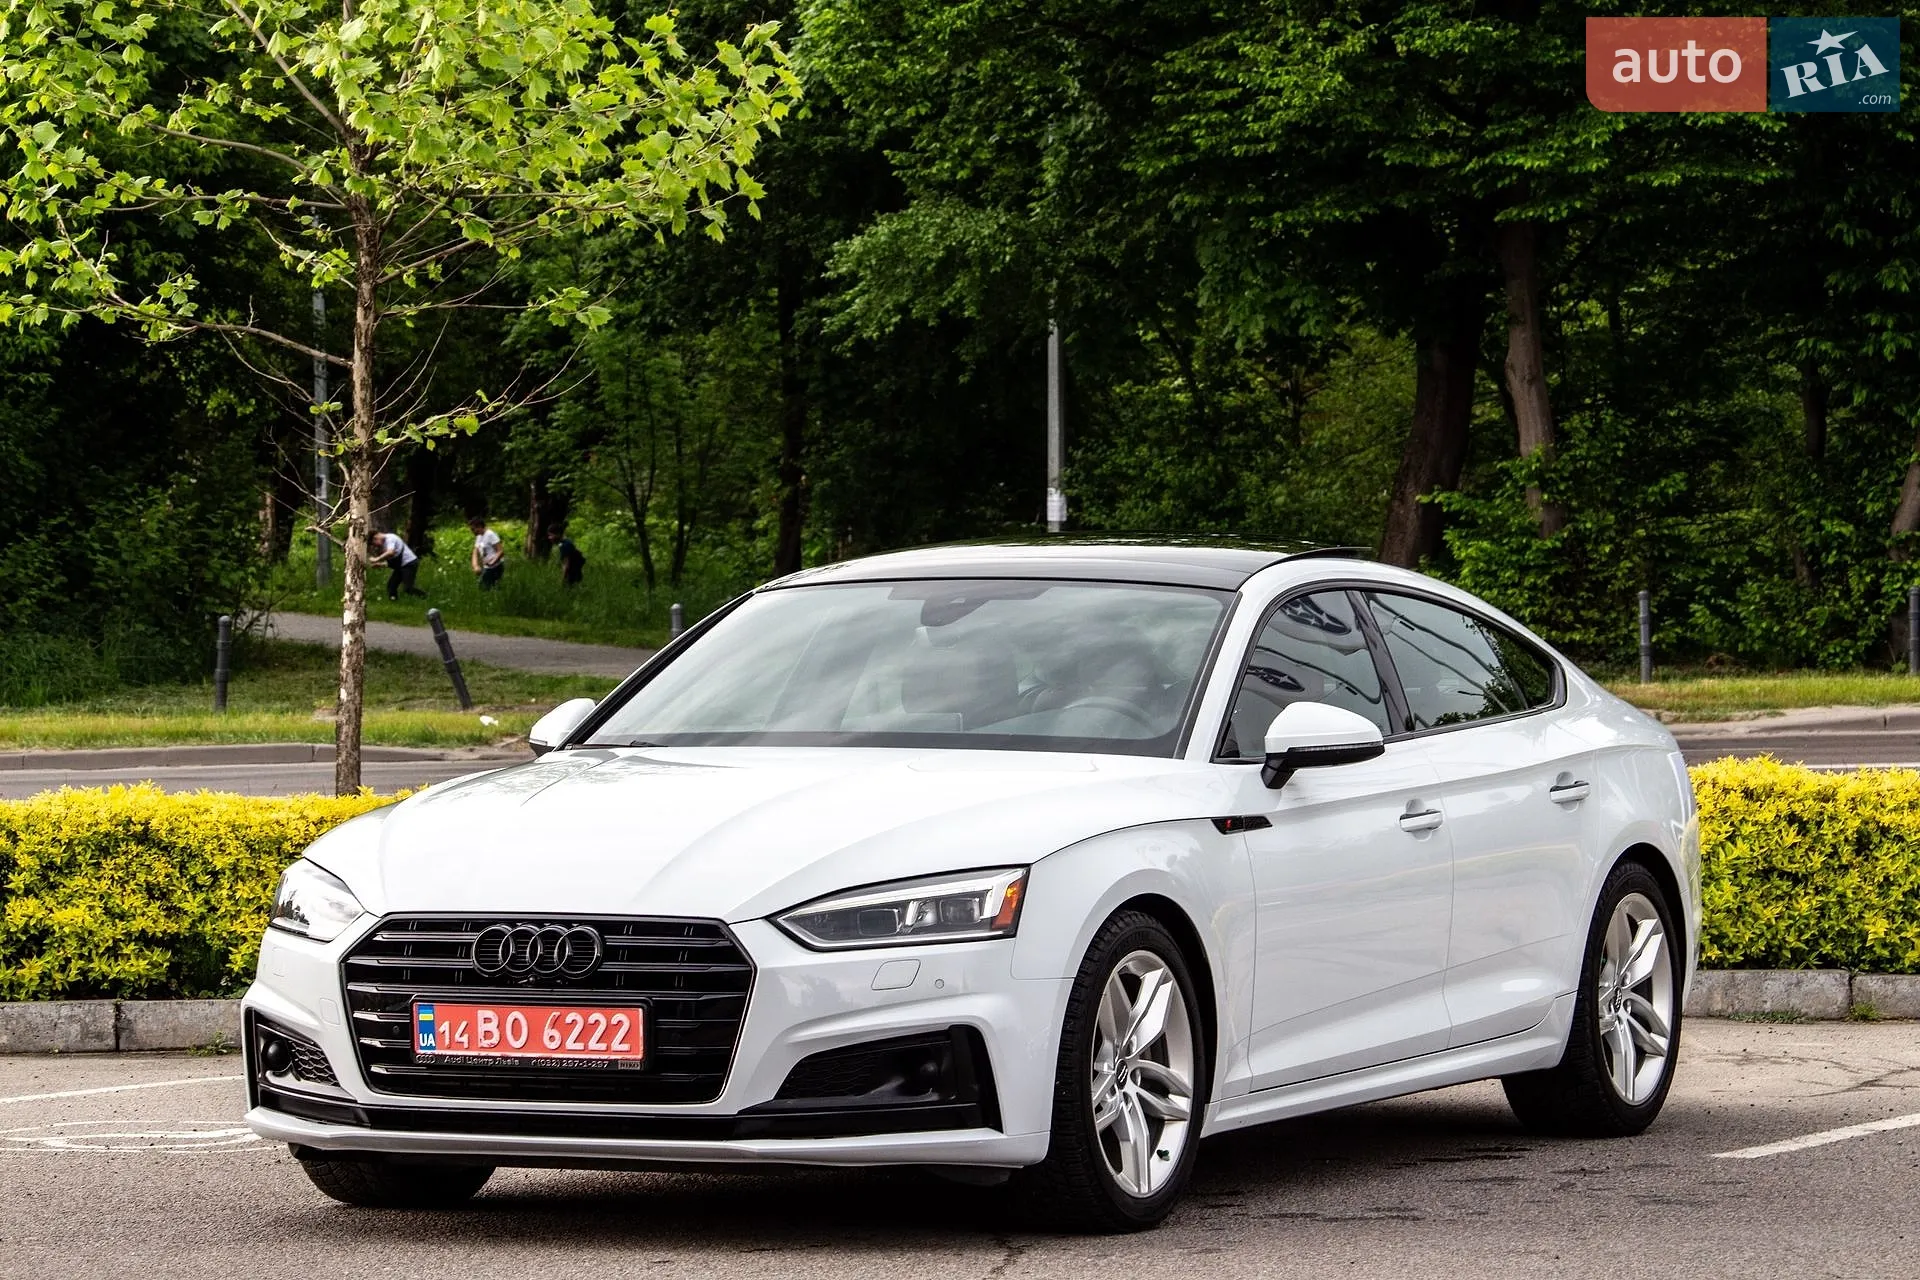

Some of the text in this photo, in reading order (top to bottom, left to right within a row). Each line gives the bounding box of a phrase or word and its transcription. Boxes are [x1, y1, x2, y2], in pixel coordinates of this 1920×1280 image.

[438, 1009, 631, 1051] 14 BO 6222
[419, 1033, 436, 1047] UA
[444, 1055, 464, 1064] Audi
